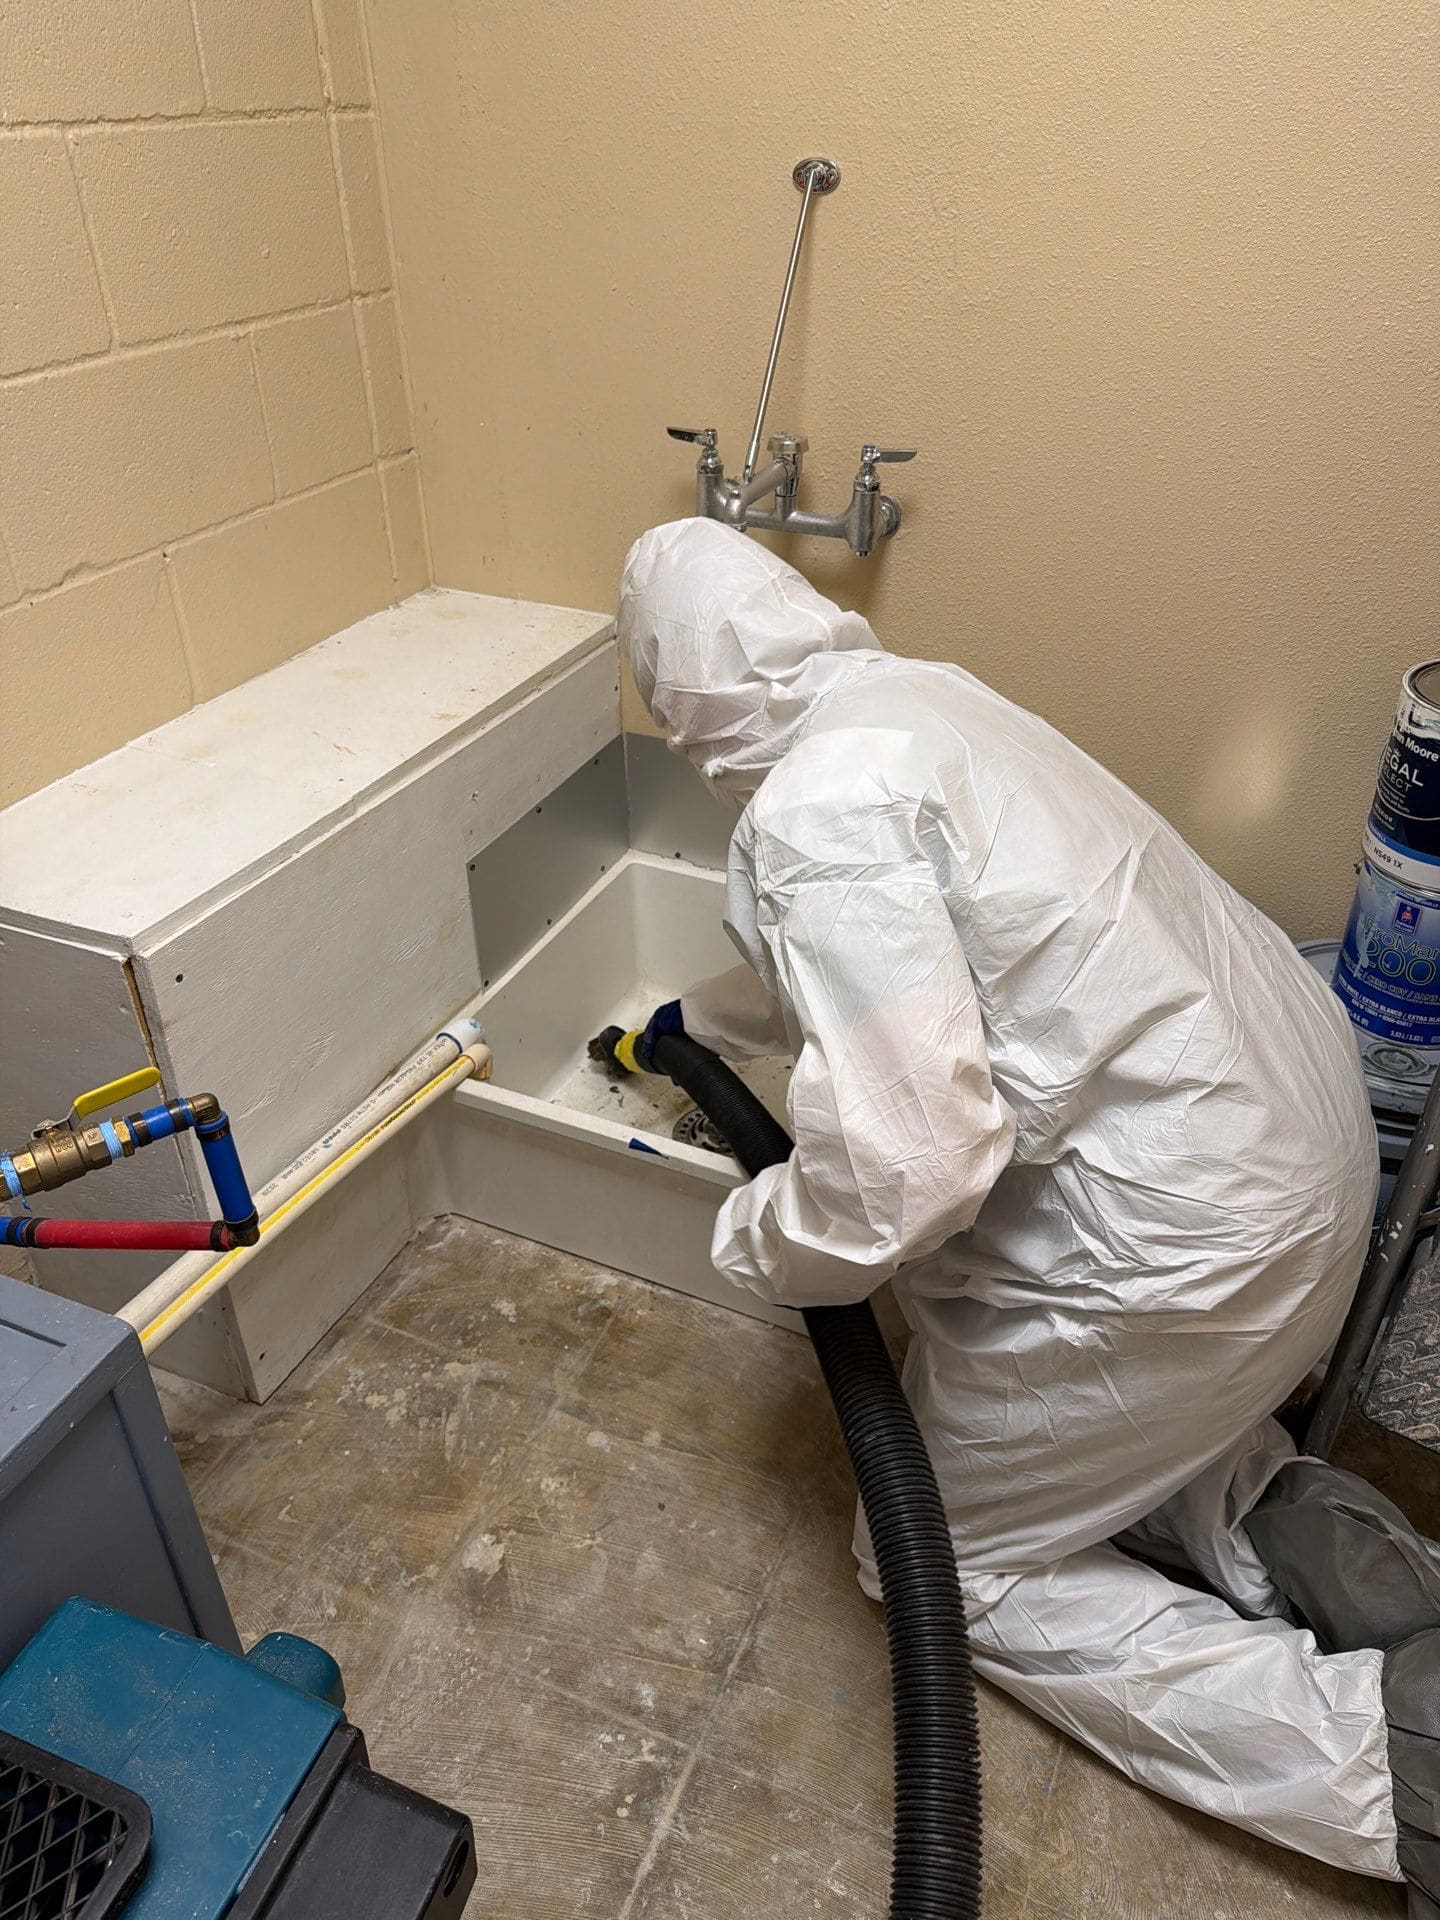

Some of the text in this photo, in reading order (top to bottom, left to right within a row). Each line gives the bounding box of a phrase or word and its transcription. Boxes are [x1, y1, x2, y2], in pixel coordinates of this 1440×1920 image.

[1405, 736, 1439, 762] Moore
[1379, 1004, 1402, 1018] BLANCO
[1408, 1013, 1427, 1022] EXTRA
